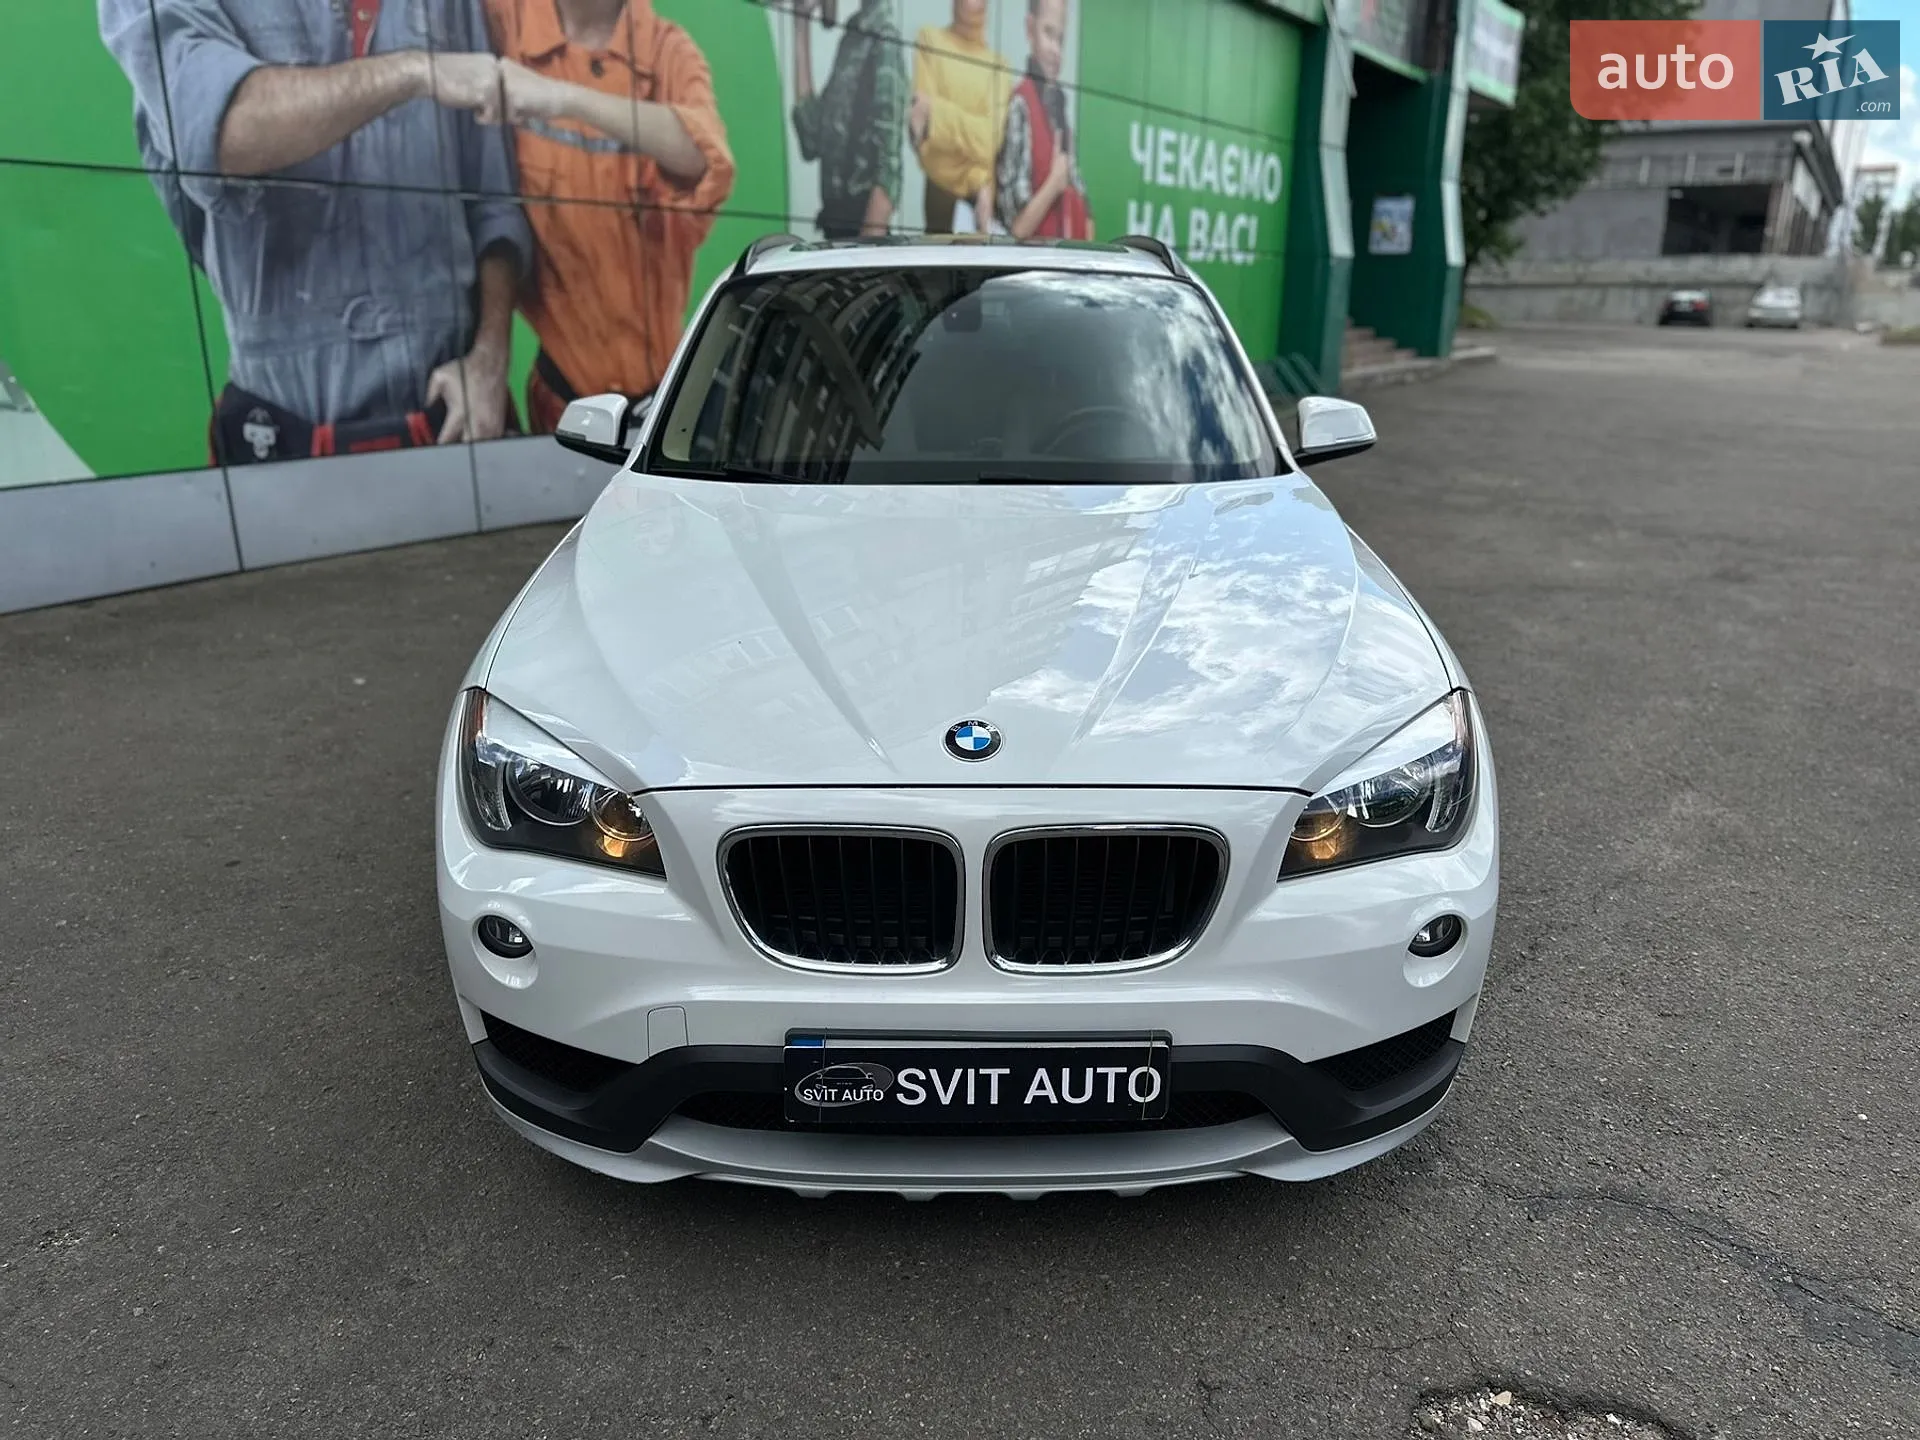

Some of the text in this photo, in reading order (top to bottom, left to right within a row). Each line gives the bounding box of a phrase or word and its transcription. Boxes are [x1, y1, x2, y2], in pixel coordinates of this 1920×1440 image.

[1129, 120, 1283, 204] ЧЕКАЄМО
[1127, 199, 1258, 265] НА ВАС!
[803, 1088, 884, 1101] SVIT AUTO
[896, 1066, 1161, 1105] SVIT AUTO
